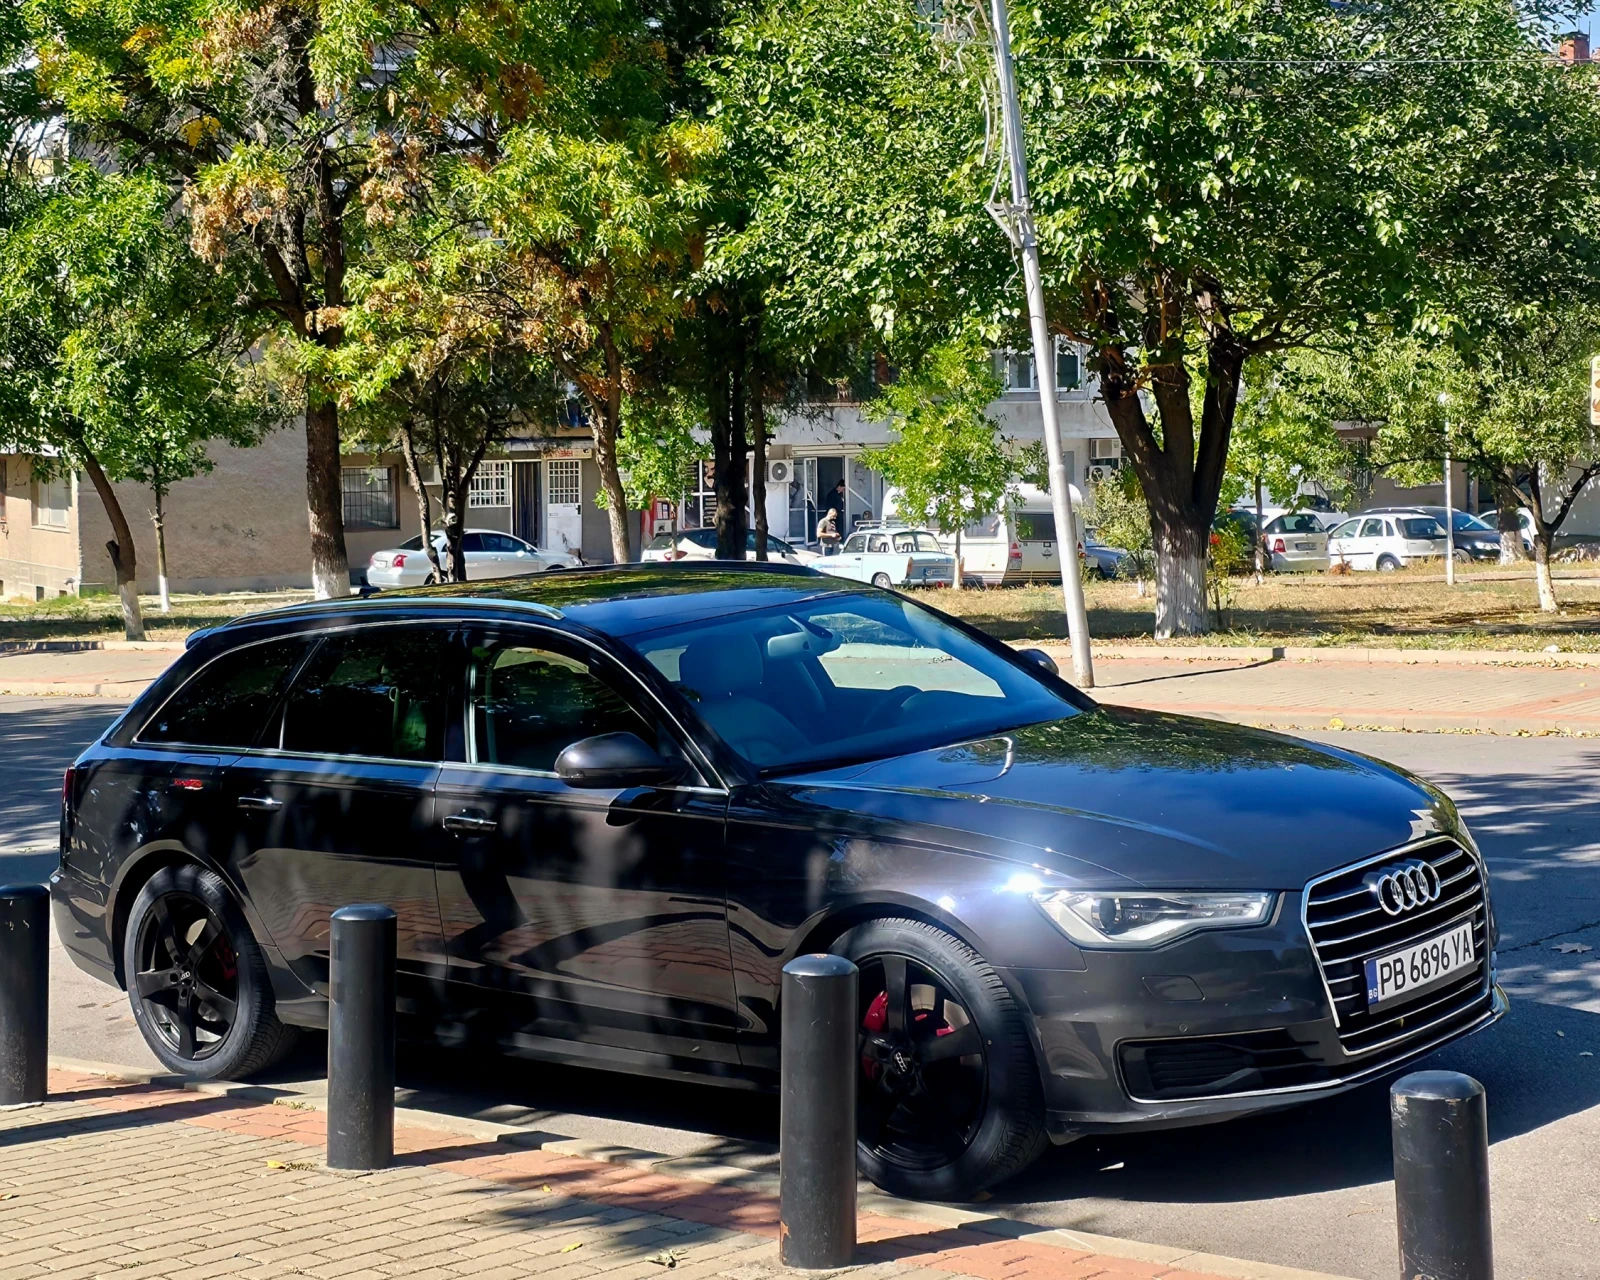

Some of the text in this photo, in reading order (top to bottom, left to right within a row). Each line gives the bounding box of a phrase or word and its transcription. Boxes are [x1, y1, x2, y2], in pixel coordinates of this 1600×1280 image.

[1380, 929, 1472, 996] PB 6896 YA
[1368, 988, 1379, 999] BG
